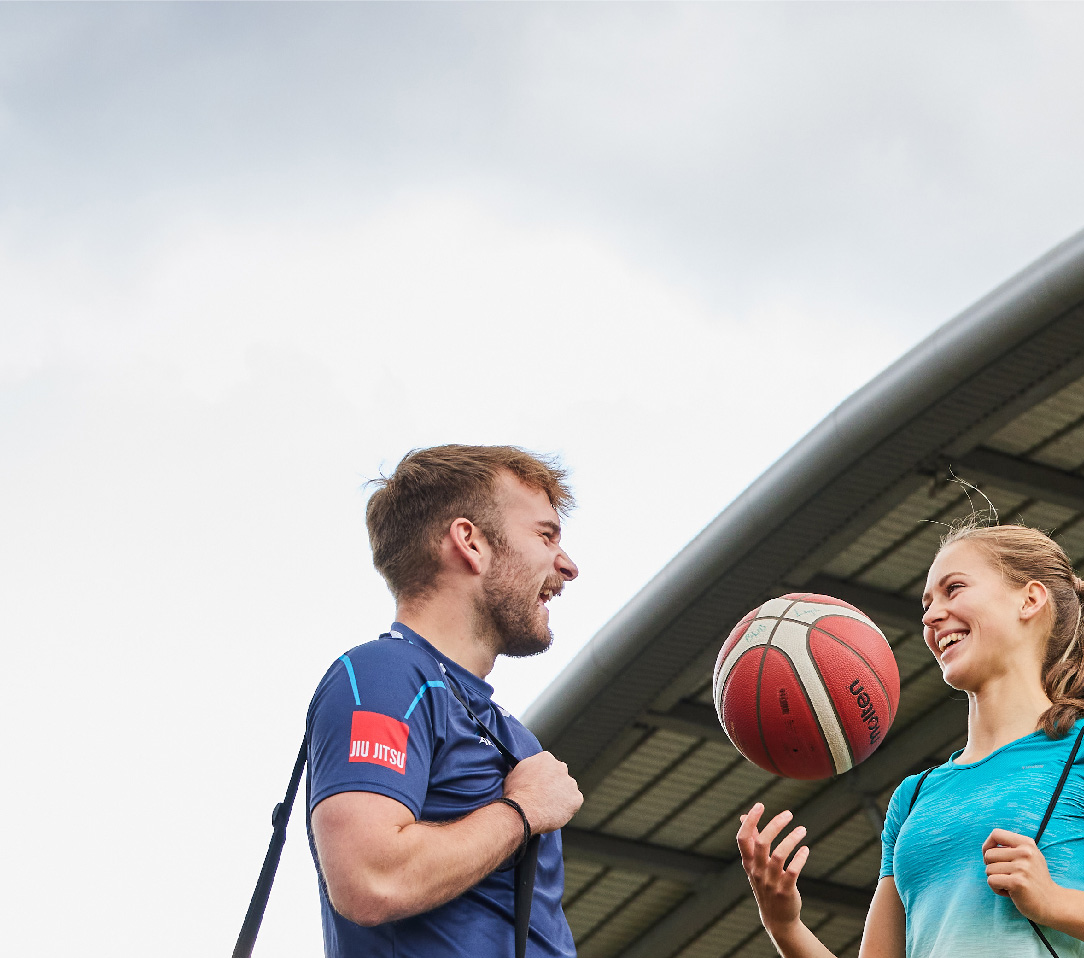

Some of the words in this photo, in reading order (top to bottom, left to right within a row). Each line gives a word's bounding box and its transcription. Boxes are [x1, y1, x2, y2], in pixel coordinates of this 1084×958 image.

[850, 678, 881, 745] molten
[349, 740, 370, 758] JIU
[372, 742, 406, 769] JITSU
